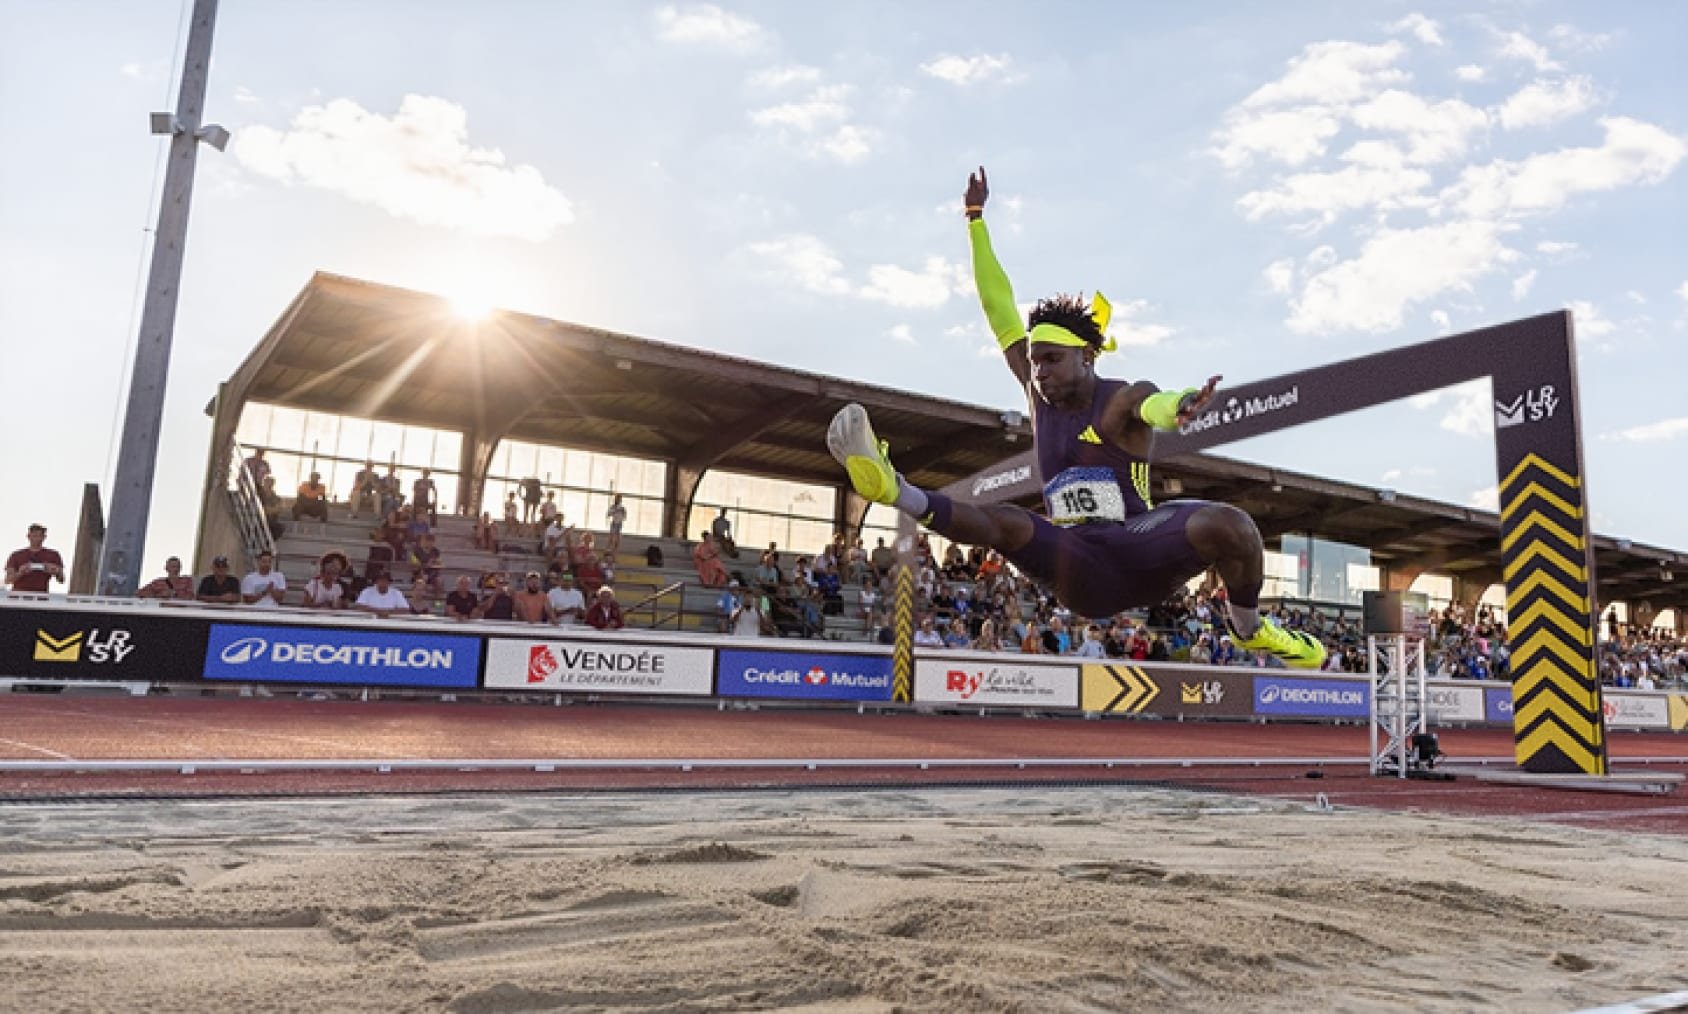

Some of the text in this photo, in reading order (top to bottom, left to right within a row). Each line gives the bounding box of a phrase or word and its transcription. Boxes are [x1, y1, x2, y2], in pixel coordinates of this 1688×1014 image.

[1246, 385, 1298, 416] Mutuel
[1063, 488, 1097, 513] 116
[271, 643, 452, 669] DECATHLON
[561, 648, 665, 674] VENDÉE
[744, 667, 889, 688] Crédit Mutuel
[1281, 688, 1364, 704] DECATHLON
